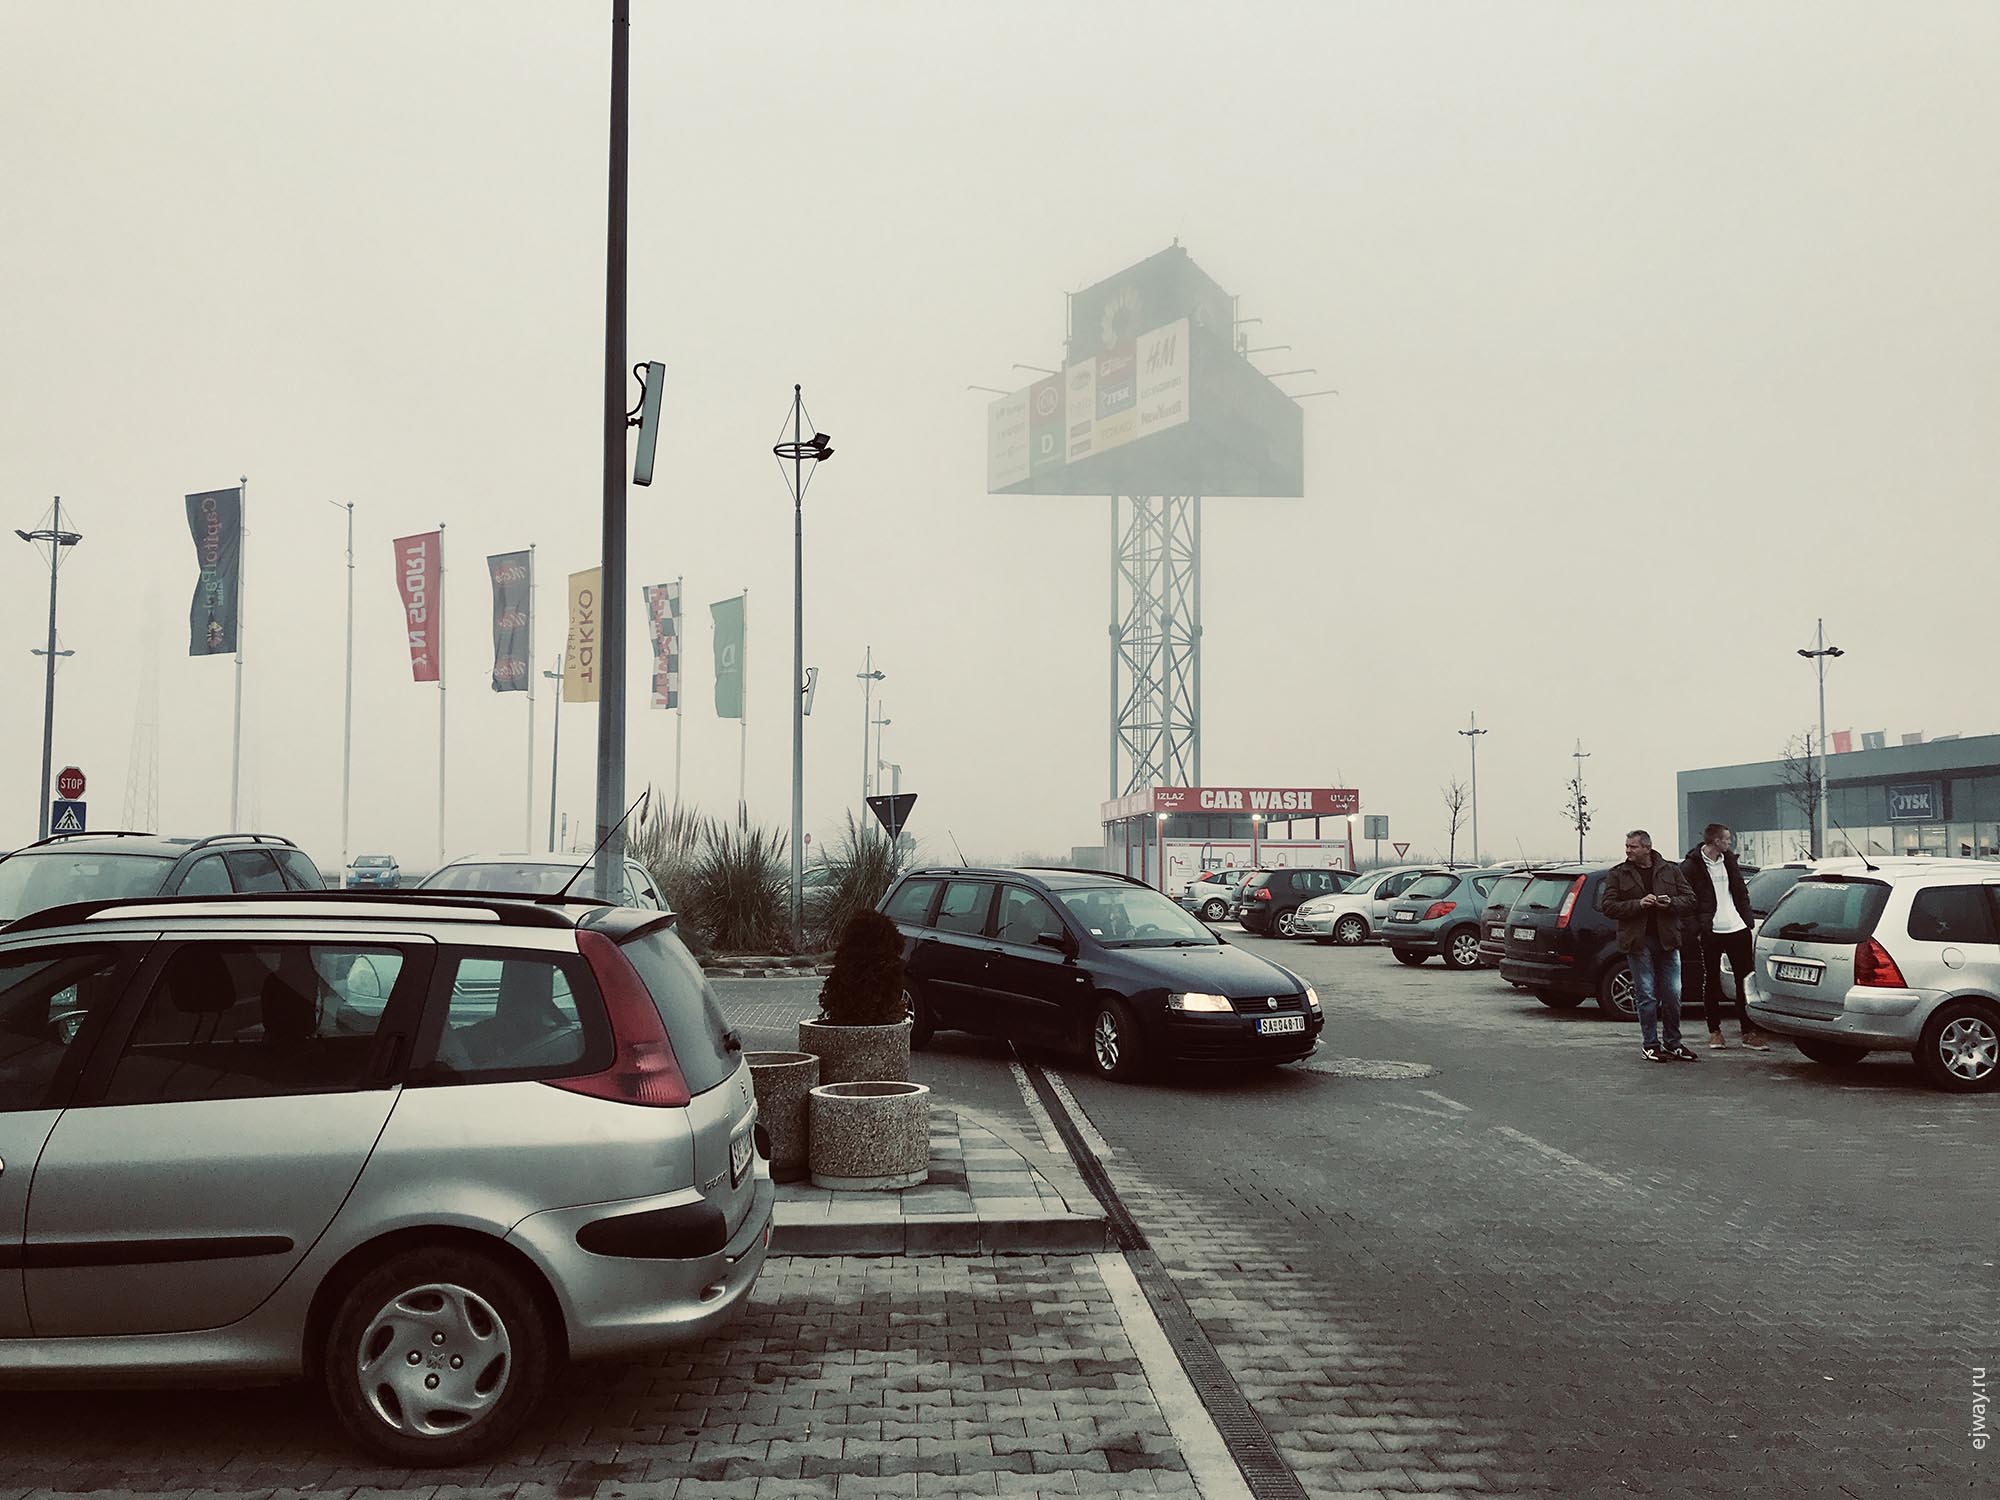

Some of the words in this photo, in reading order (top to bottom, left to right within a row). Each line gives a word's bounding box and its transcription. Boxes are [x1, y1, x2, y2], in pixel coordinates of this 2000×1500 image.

[60, 778, 83, 790] STOP
[1157, 792, 1184, 800] IZLAZ
[1200, 790, 1242, 809] CAR
[1249, 791, 1313, 810] WASH
[1898, 793, 1930, 810] JYSK
[1262, 1020, 1273, 1033] SA
